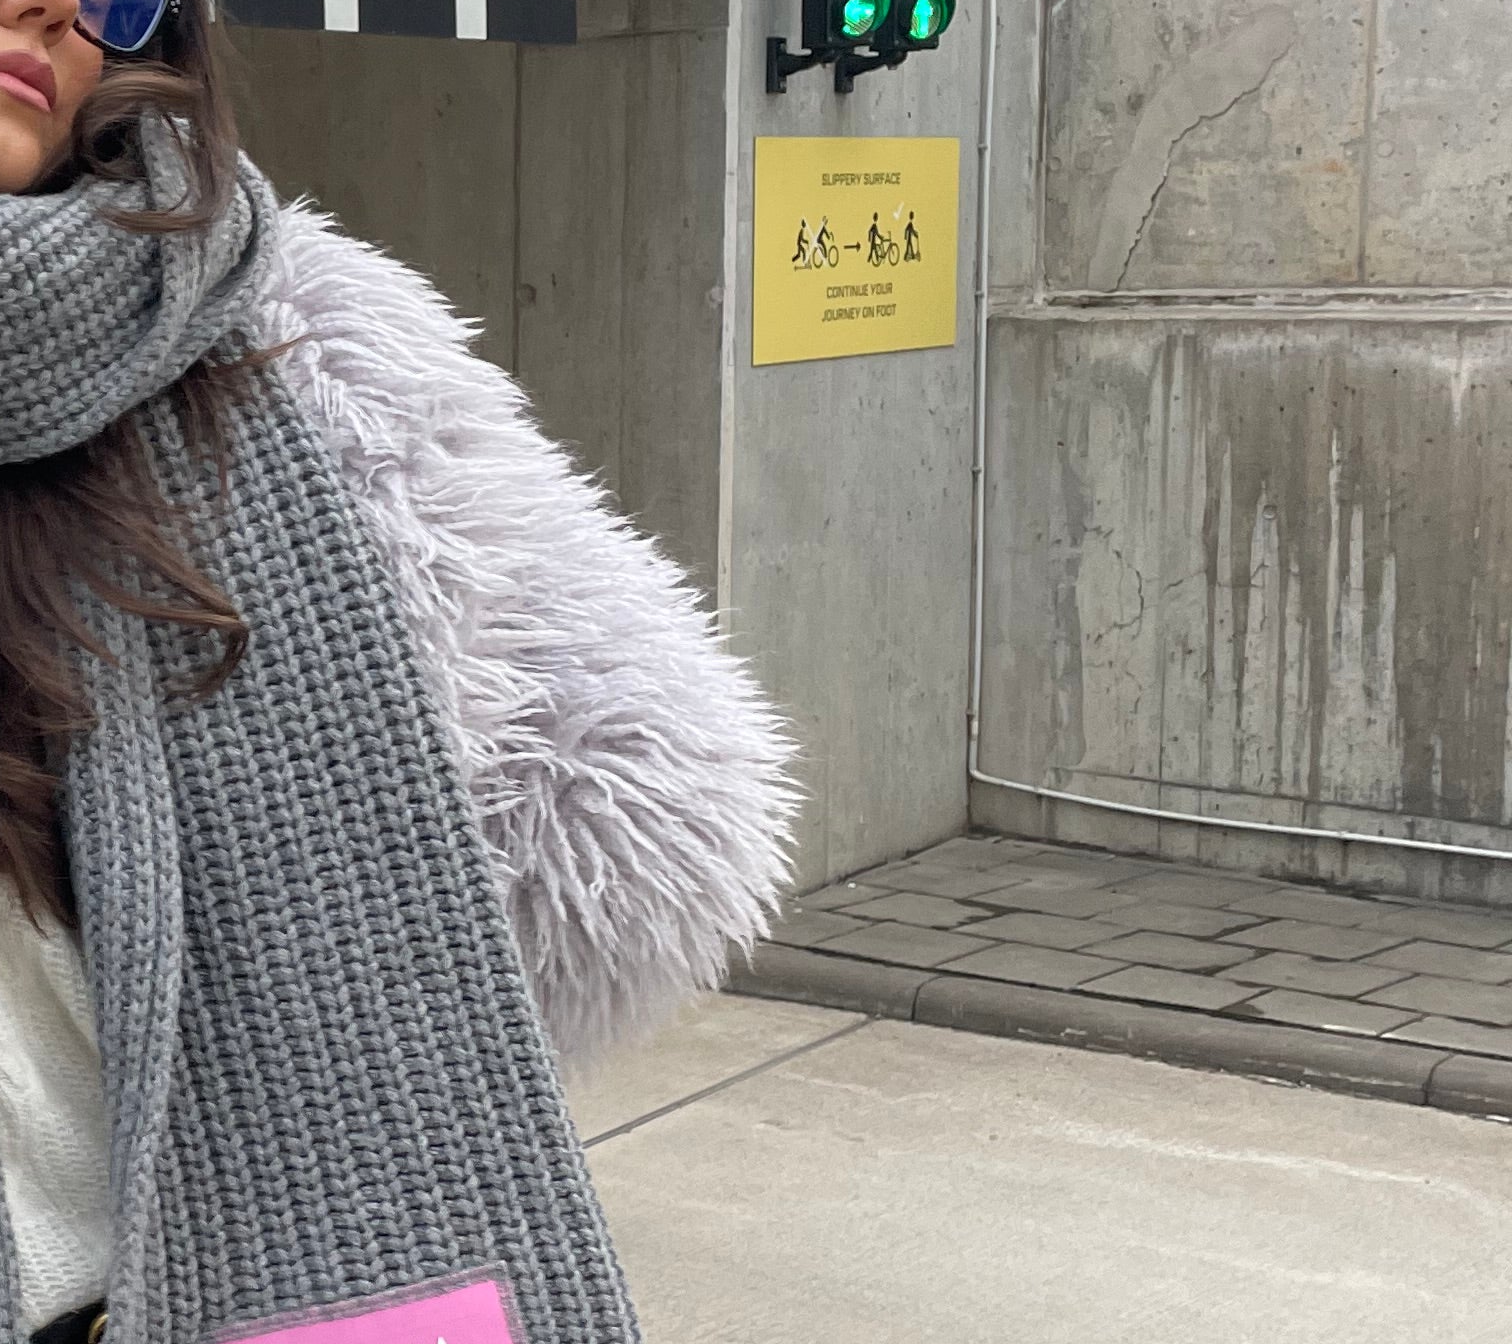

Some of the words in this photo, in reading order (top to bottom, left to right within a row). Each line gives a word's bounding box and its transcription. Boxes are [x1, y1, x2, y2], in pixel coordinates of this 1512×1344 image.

[821, 172, 862, 187] SLIPPERY
[863, 171, 902, 186] SURFACE
[826, 283, 869, 299] CONTINUE
[870, 281, 893, 296] YOUR
[821, 306, 862, 323] JOURNEY
[862, 305, 876, 319] ON
[876, 303, 897, 317] FOOT
